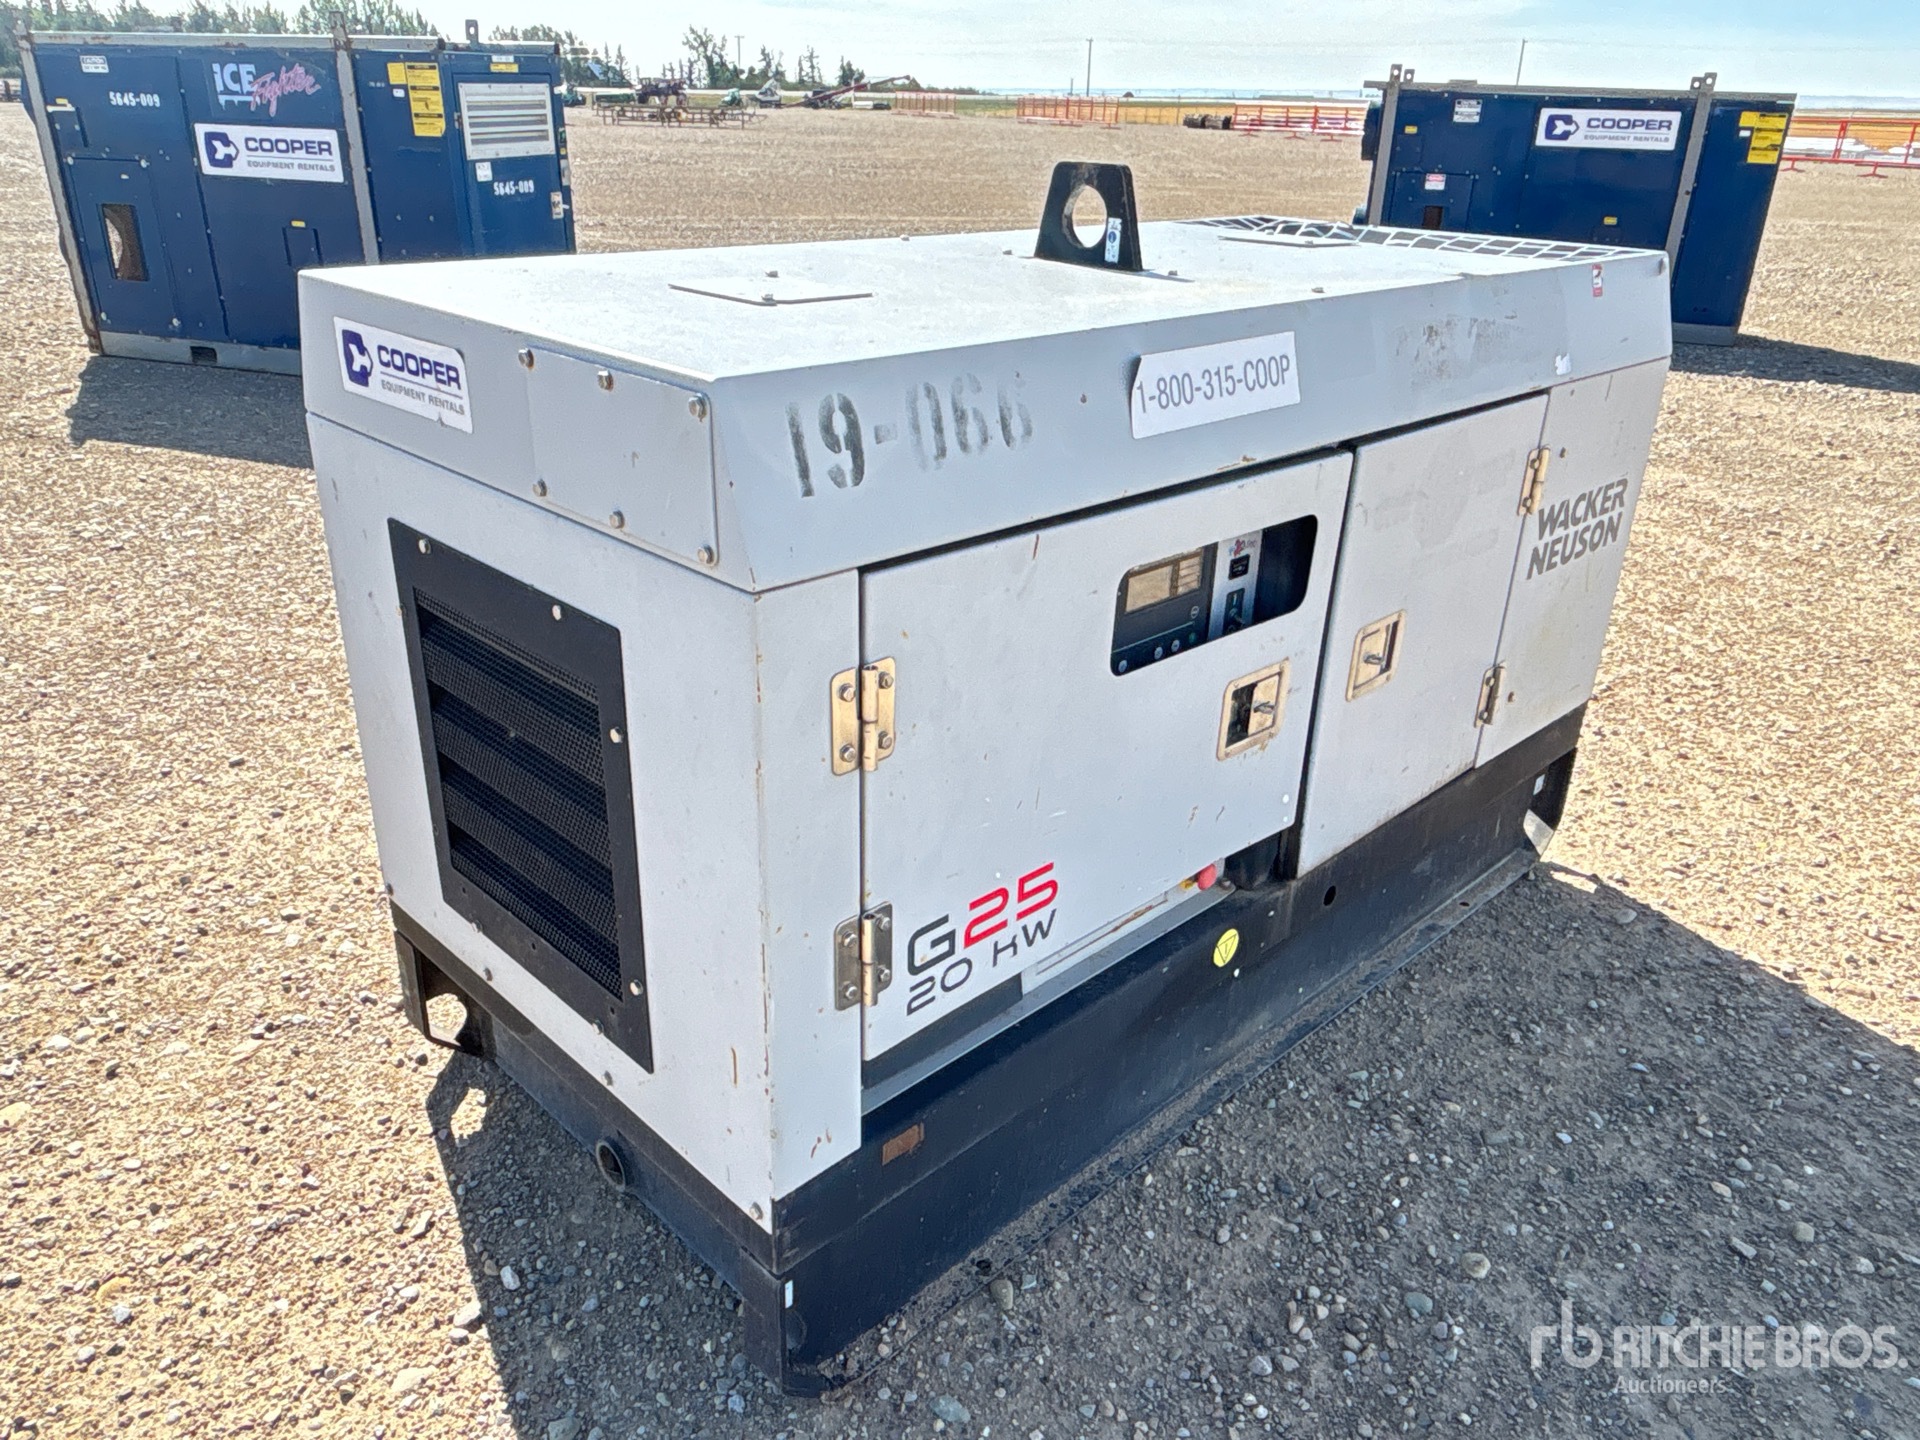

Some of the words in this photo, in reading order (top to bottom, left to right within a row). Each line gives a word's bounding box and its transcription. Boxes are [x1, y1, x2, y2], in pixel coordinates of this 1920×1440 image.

[212, 63, 257, 95] ICE
[1584, 134, 1631, 142] EQUIPMENT
[1633, 135, 1669, 143] RENTALS
[1586, 117, 1673, 132] COOPER
[245, 137, 333, 156] COOPER
[247, 159, 294, 170] EQUIPMENT
[298, 163, 335, 172] RENTALS
[377, 344, 461, 390] COOPER
[1136, 354, 1291, 414] 1-800-315-COOP
[381, 379, 426, 404] EQUIPMENT
[428, 394, 465, 416] RENTALS
[1538, 478, 1628, 541] WACKER
[1526, 510, 1623, 580] NEUSON
[907, 861, 1058, 977] G25
[906, 957, 973, 1017] 20
